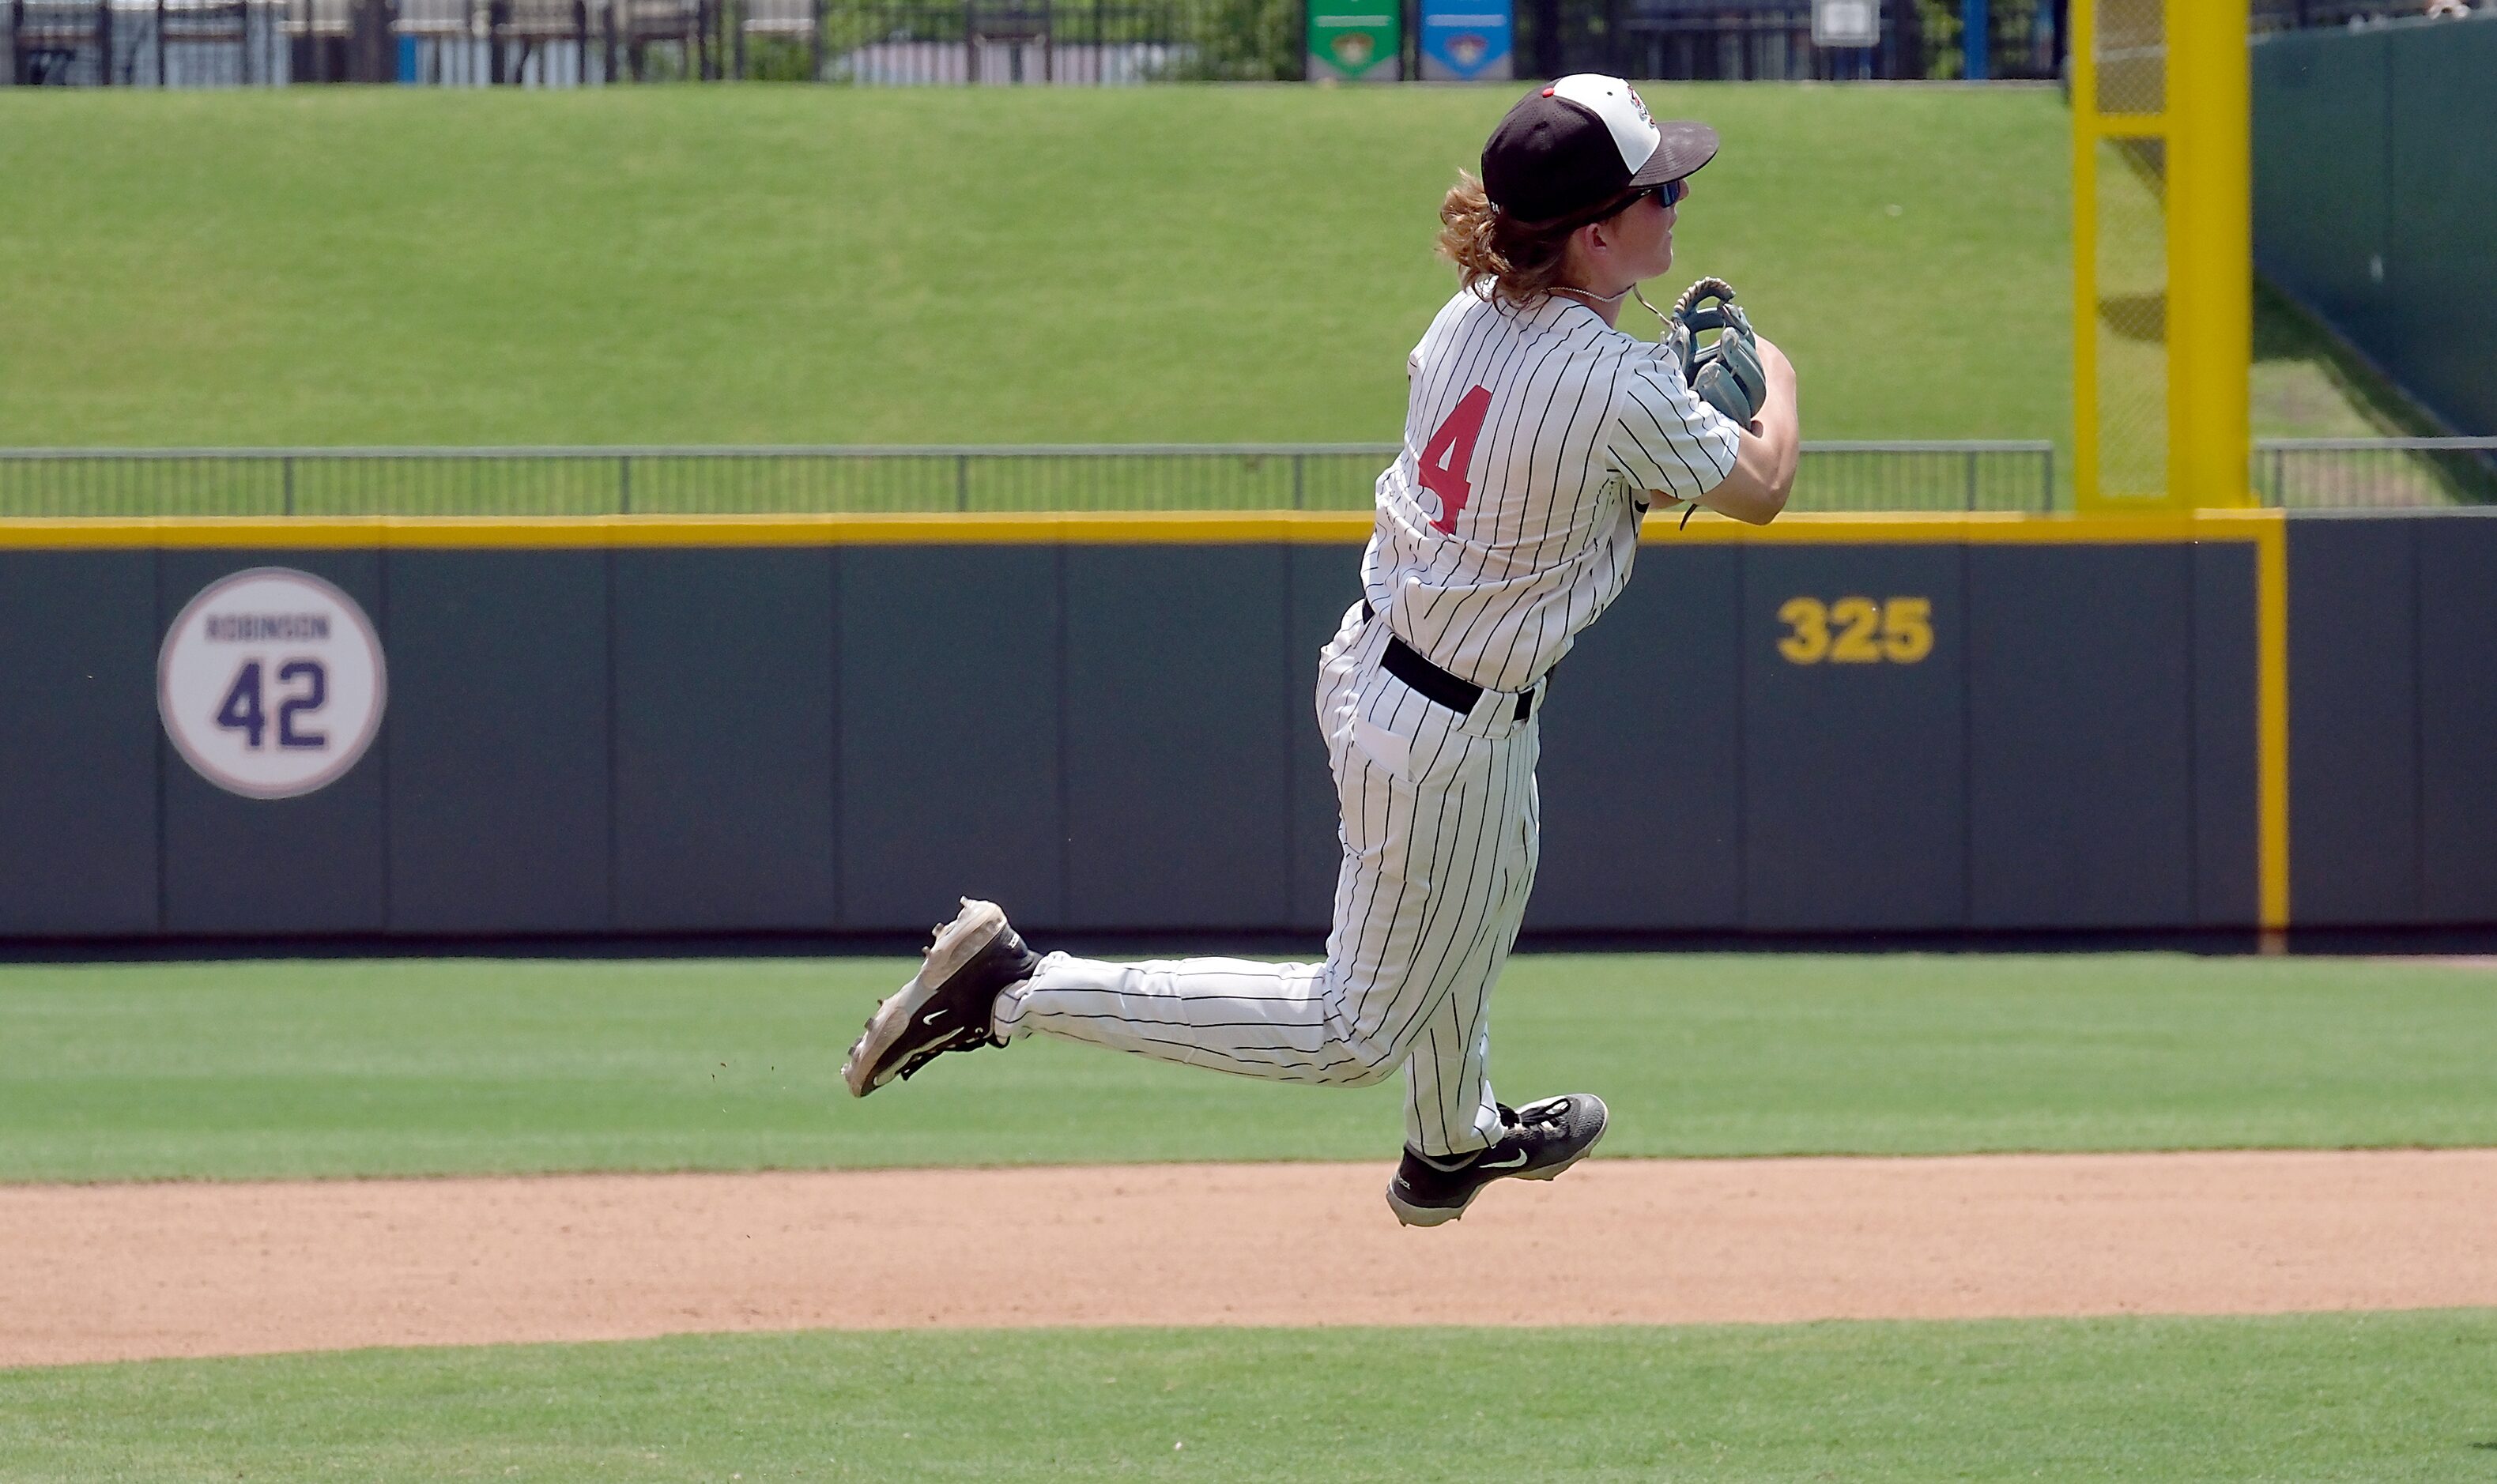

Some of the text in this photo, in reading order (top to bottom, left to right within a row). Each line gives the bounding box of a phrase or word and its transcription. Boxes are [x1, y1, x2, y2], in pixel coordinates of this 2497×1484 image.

[1418, 384, 1492, 536] 4
[1778, 597, 1934, 665] 325
[216, 661, 326, 748] 42
